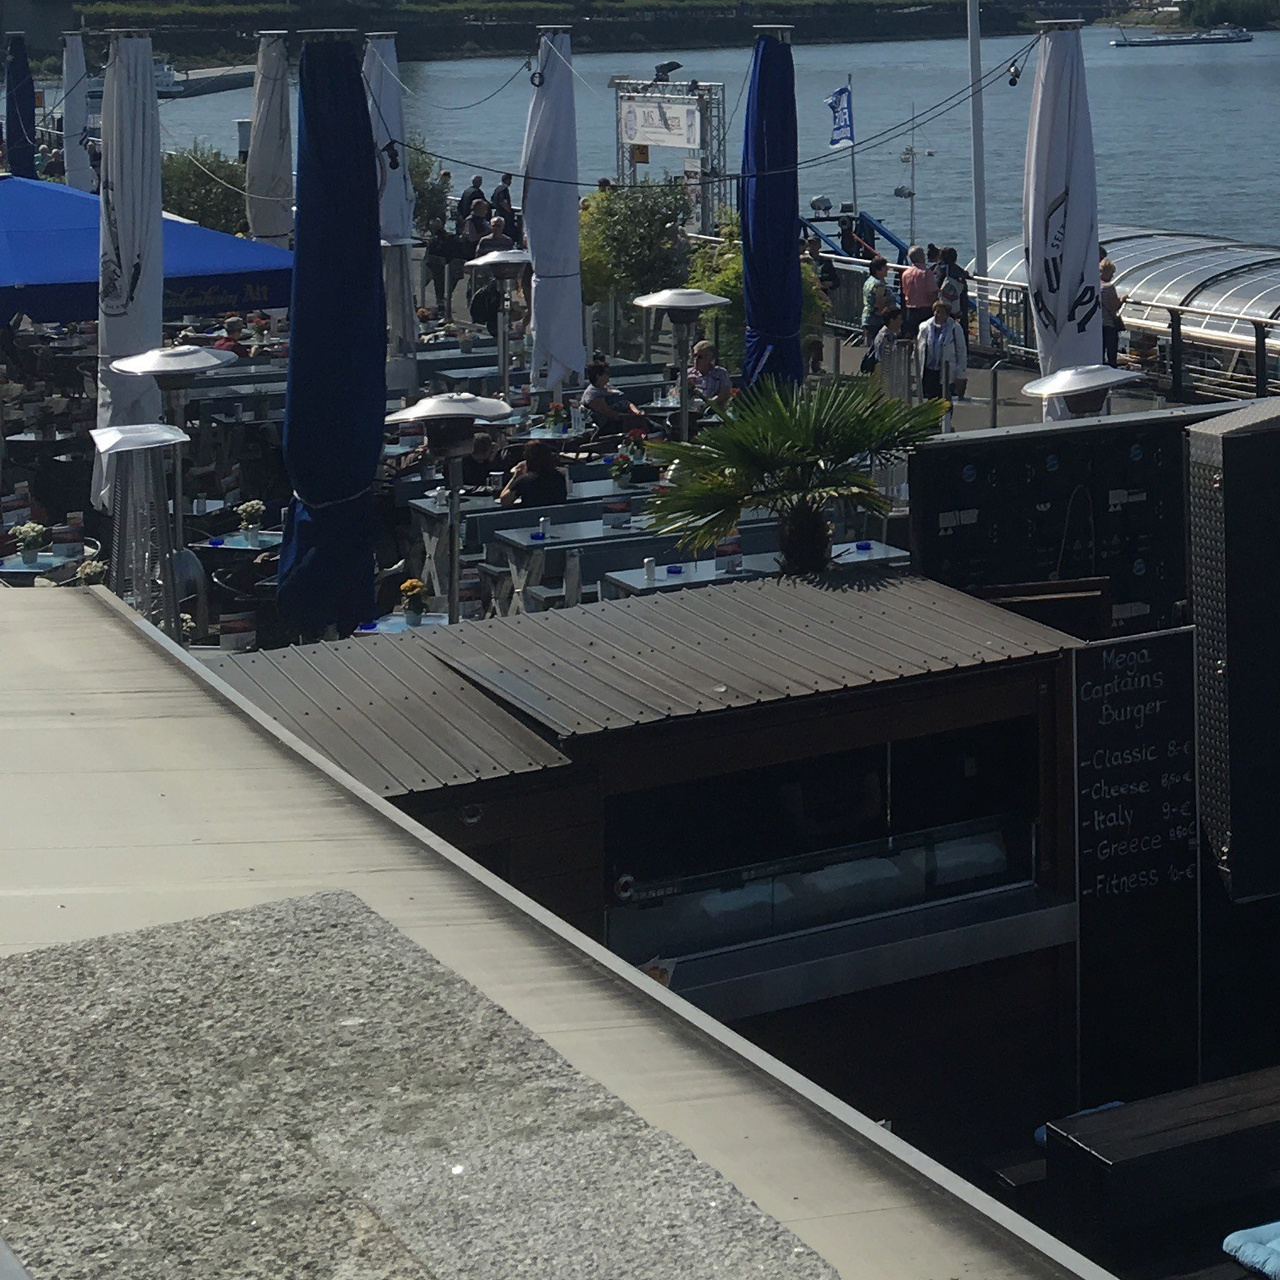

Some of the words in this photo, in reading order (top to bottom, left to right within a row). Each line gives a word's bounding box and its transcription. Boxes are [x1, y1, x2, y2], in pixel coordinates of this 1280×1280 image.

[1102, 648, 1153, 676] Mega
[1080, 671, 1164, 703] Captains
[1098, 699, 1168, 730] Burger
